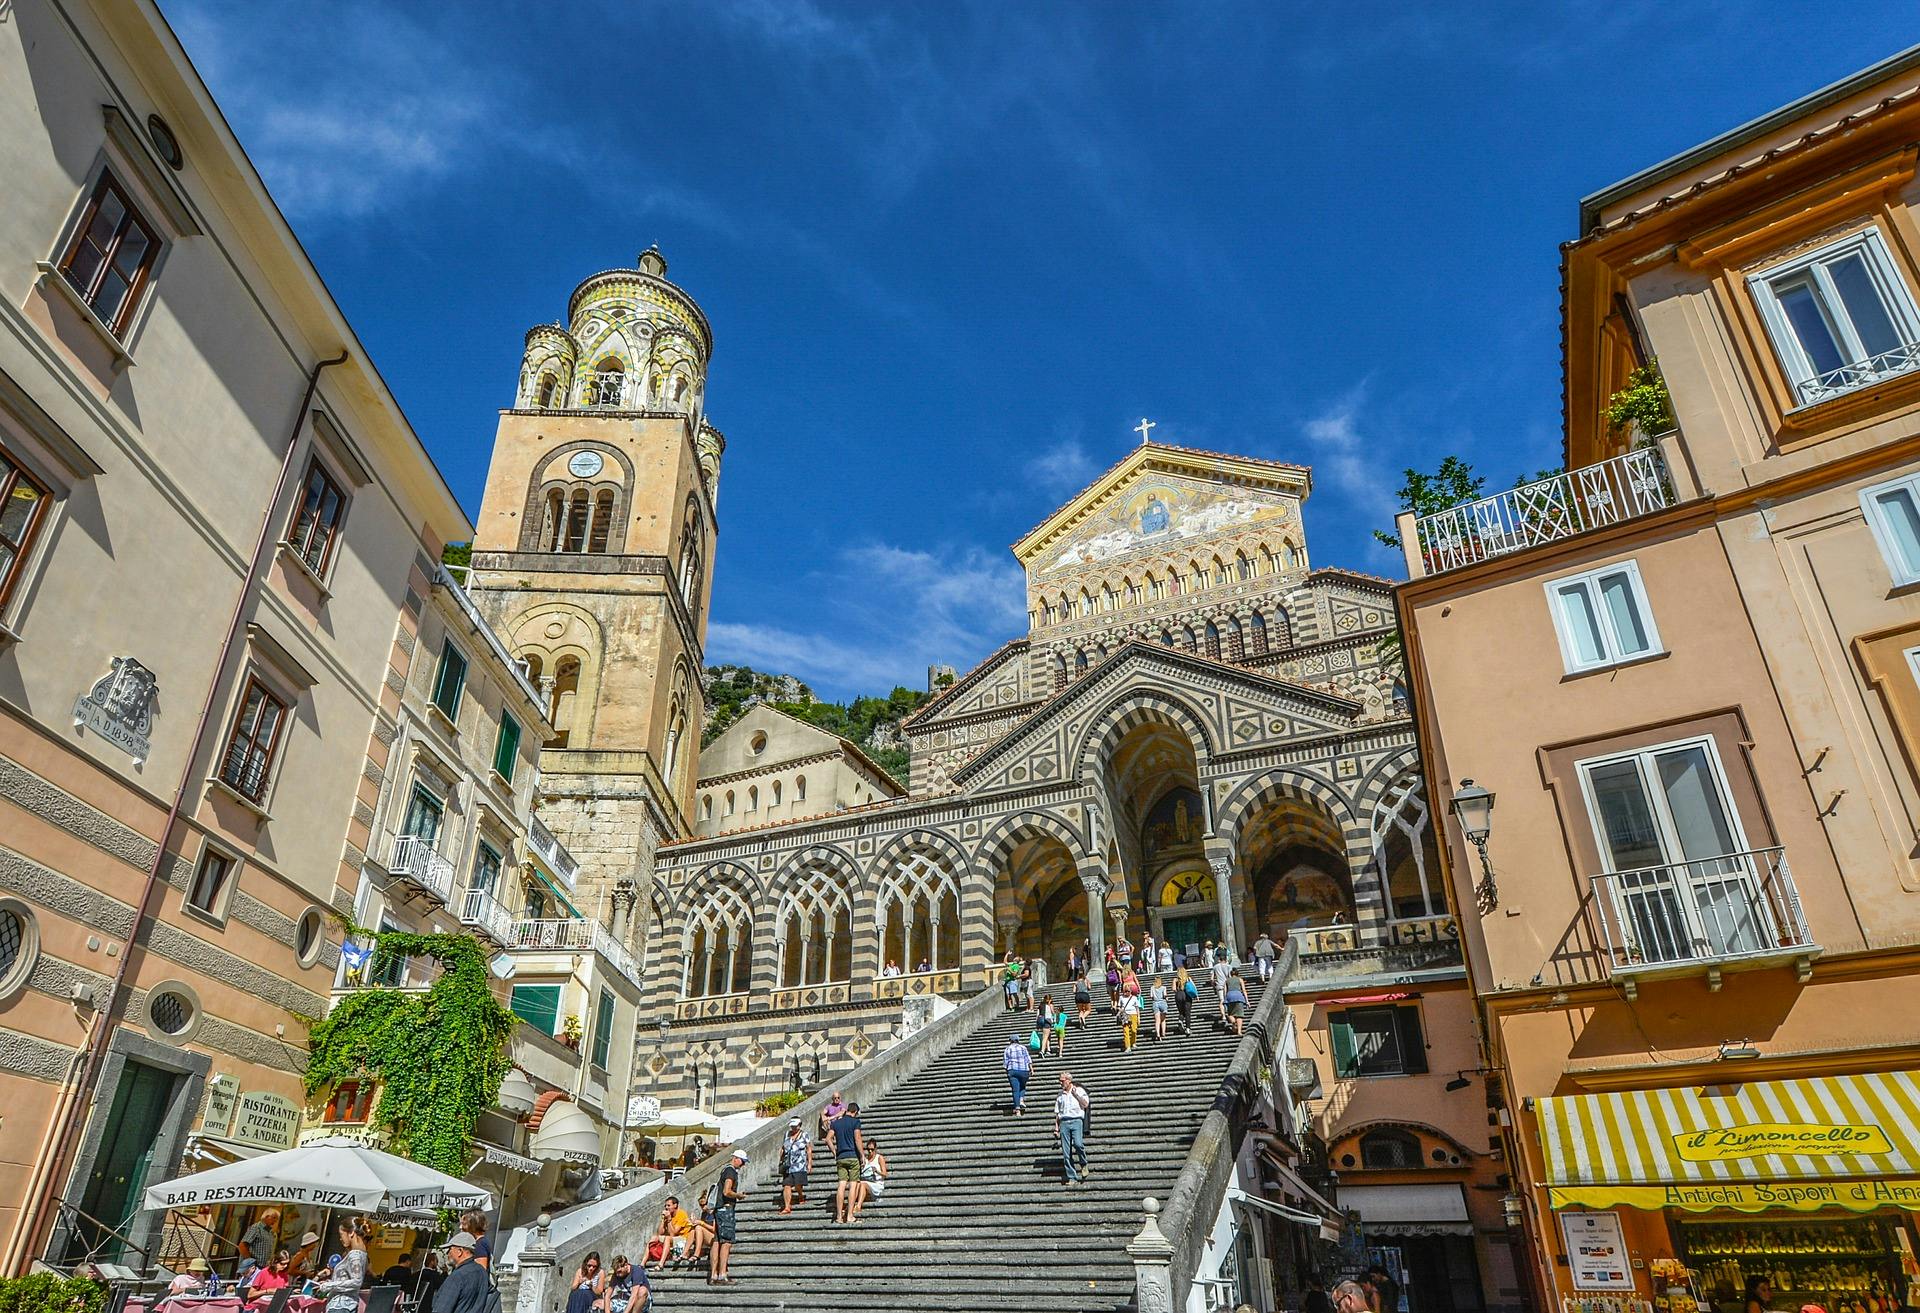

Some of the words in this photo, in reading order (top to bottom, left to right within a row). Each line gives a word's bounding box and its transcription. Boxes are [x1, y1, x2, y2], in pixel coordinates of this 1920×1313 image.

[94, 715, 101, 726] A
[103, 721, 111, 731] D
[111, 726, 134, 748] 1898
[212, 1101, 228, 1112] BEER
[263, 1094, 271, 1102] dal
[243, 1098, 298, 1121] RISTORANTE
[204, 1120, 226, 1131] COFFEE
[247, 1113, 287, 1132] PIZZERIA
[240, 1125, 249, 1137] S.
[252, 1128, 288, 1146] ANDREA
[1687, 1133, 1707, 1149] il
[1714, 1128, 1871, 1147] Limoncello
[488, 1150, 519, 1167] RISTORANTE
[167, 1190, 198, 1205] BAR
[204, 1185, 307, 1201] RESTAURANT
[312, 1189, 357, 1206] PIZZA
[395, 1194, 426, 1209] LIGHT
[455, 1197, 483, 1209] PIZZA
[1664, 1183, 1745, 1203] Antichi
[1753, 1181, 1839, 1205] Sapori
[368, 1211, 409, 1225] RISTORANTE
